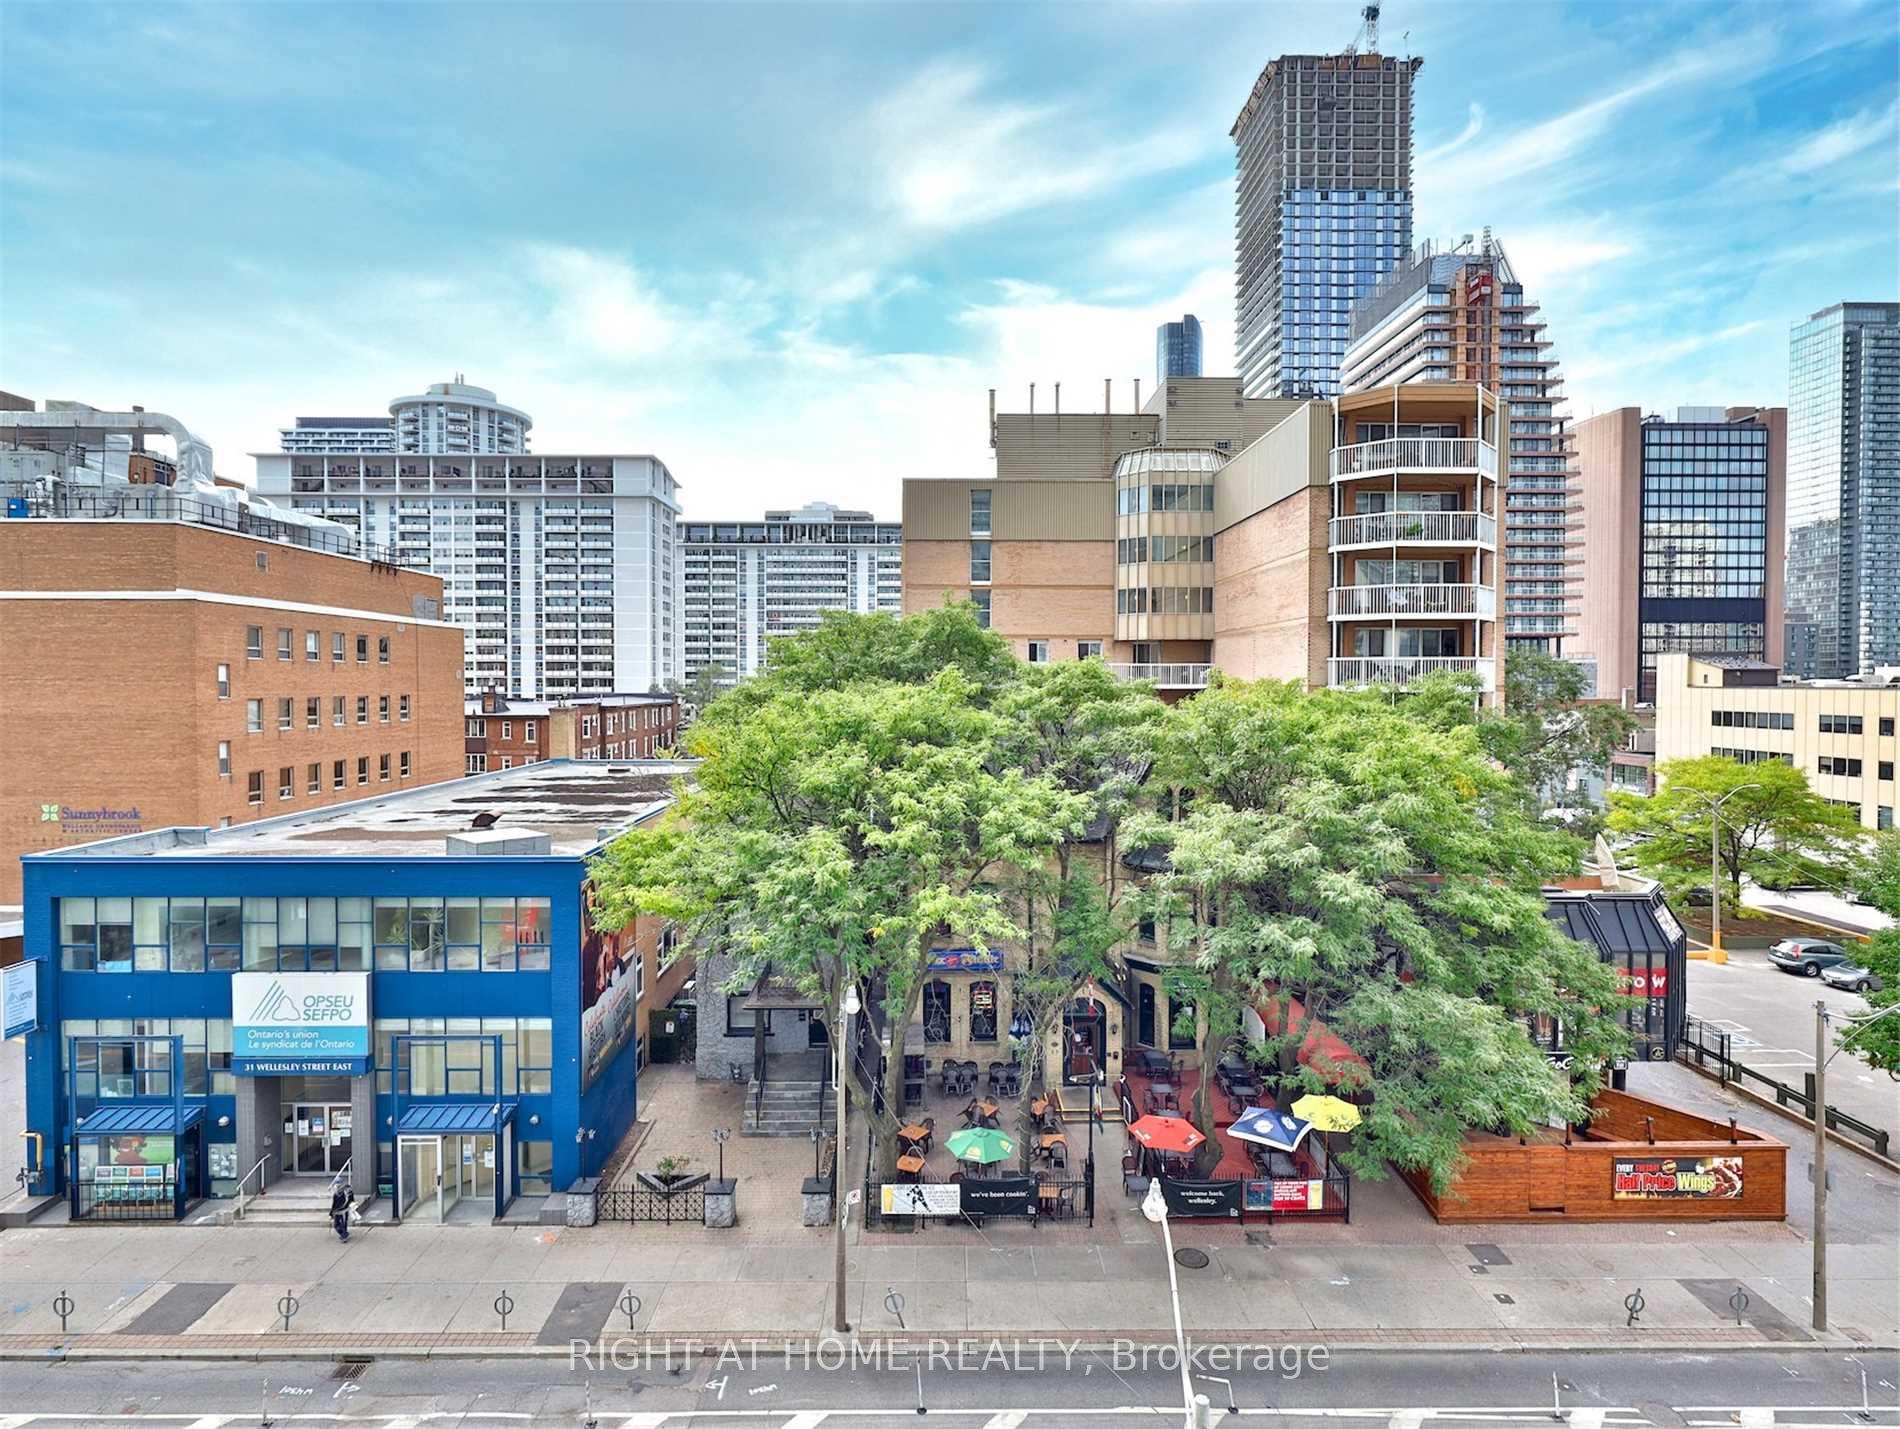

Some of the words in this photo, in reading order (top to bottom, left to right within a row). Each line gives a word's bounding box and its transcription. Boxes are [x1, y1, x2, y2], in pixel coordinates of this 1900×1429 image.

[62, 807, 140, 822] Sunnybrook
[303, 995, 354, 1008] OPSEU
[303, 1008, 352, 1021] SEFPO
[247, 1029, 290, 1039] Ontario's
[293, 1030, 319, 1039] union
[248, 1040, 261, 1049] Le
[262, 1040, 299, 1050] syndicat
[300, 1040, 313, 1049] de
[315, 1039, 356, 1049] l'Ontario
[244, 1063, 254, 1071] 31
[256, 1063, 300, 1071] WELLESLEY
[302, 1063, 330, 1071] STREET
[332, 1063, 353, 1071] EAST
[1616, 1164, 1634, 1173] EVERY
[1616, 1172, 1641, 1191] Half
[1641, 1172, 1677, 1191] Price
[1677, 1172, 1716, 1193] Wings
